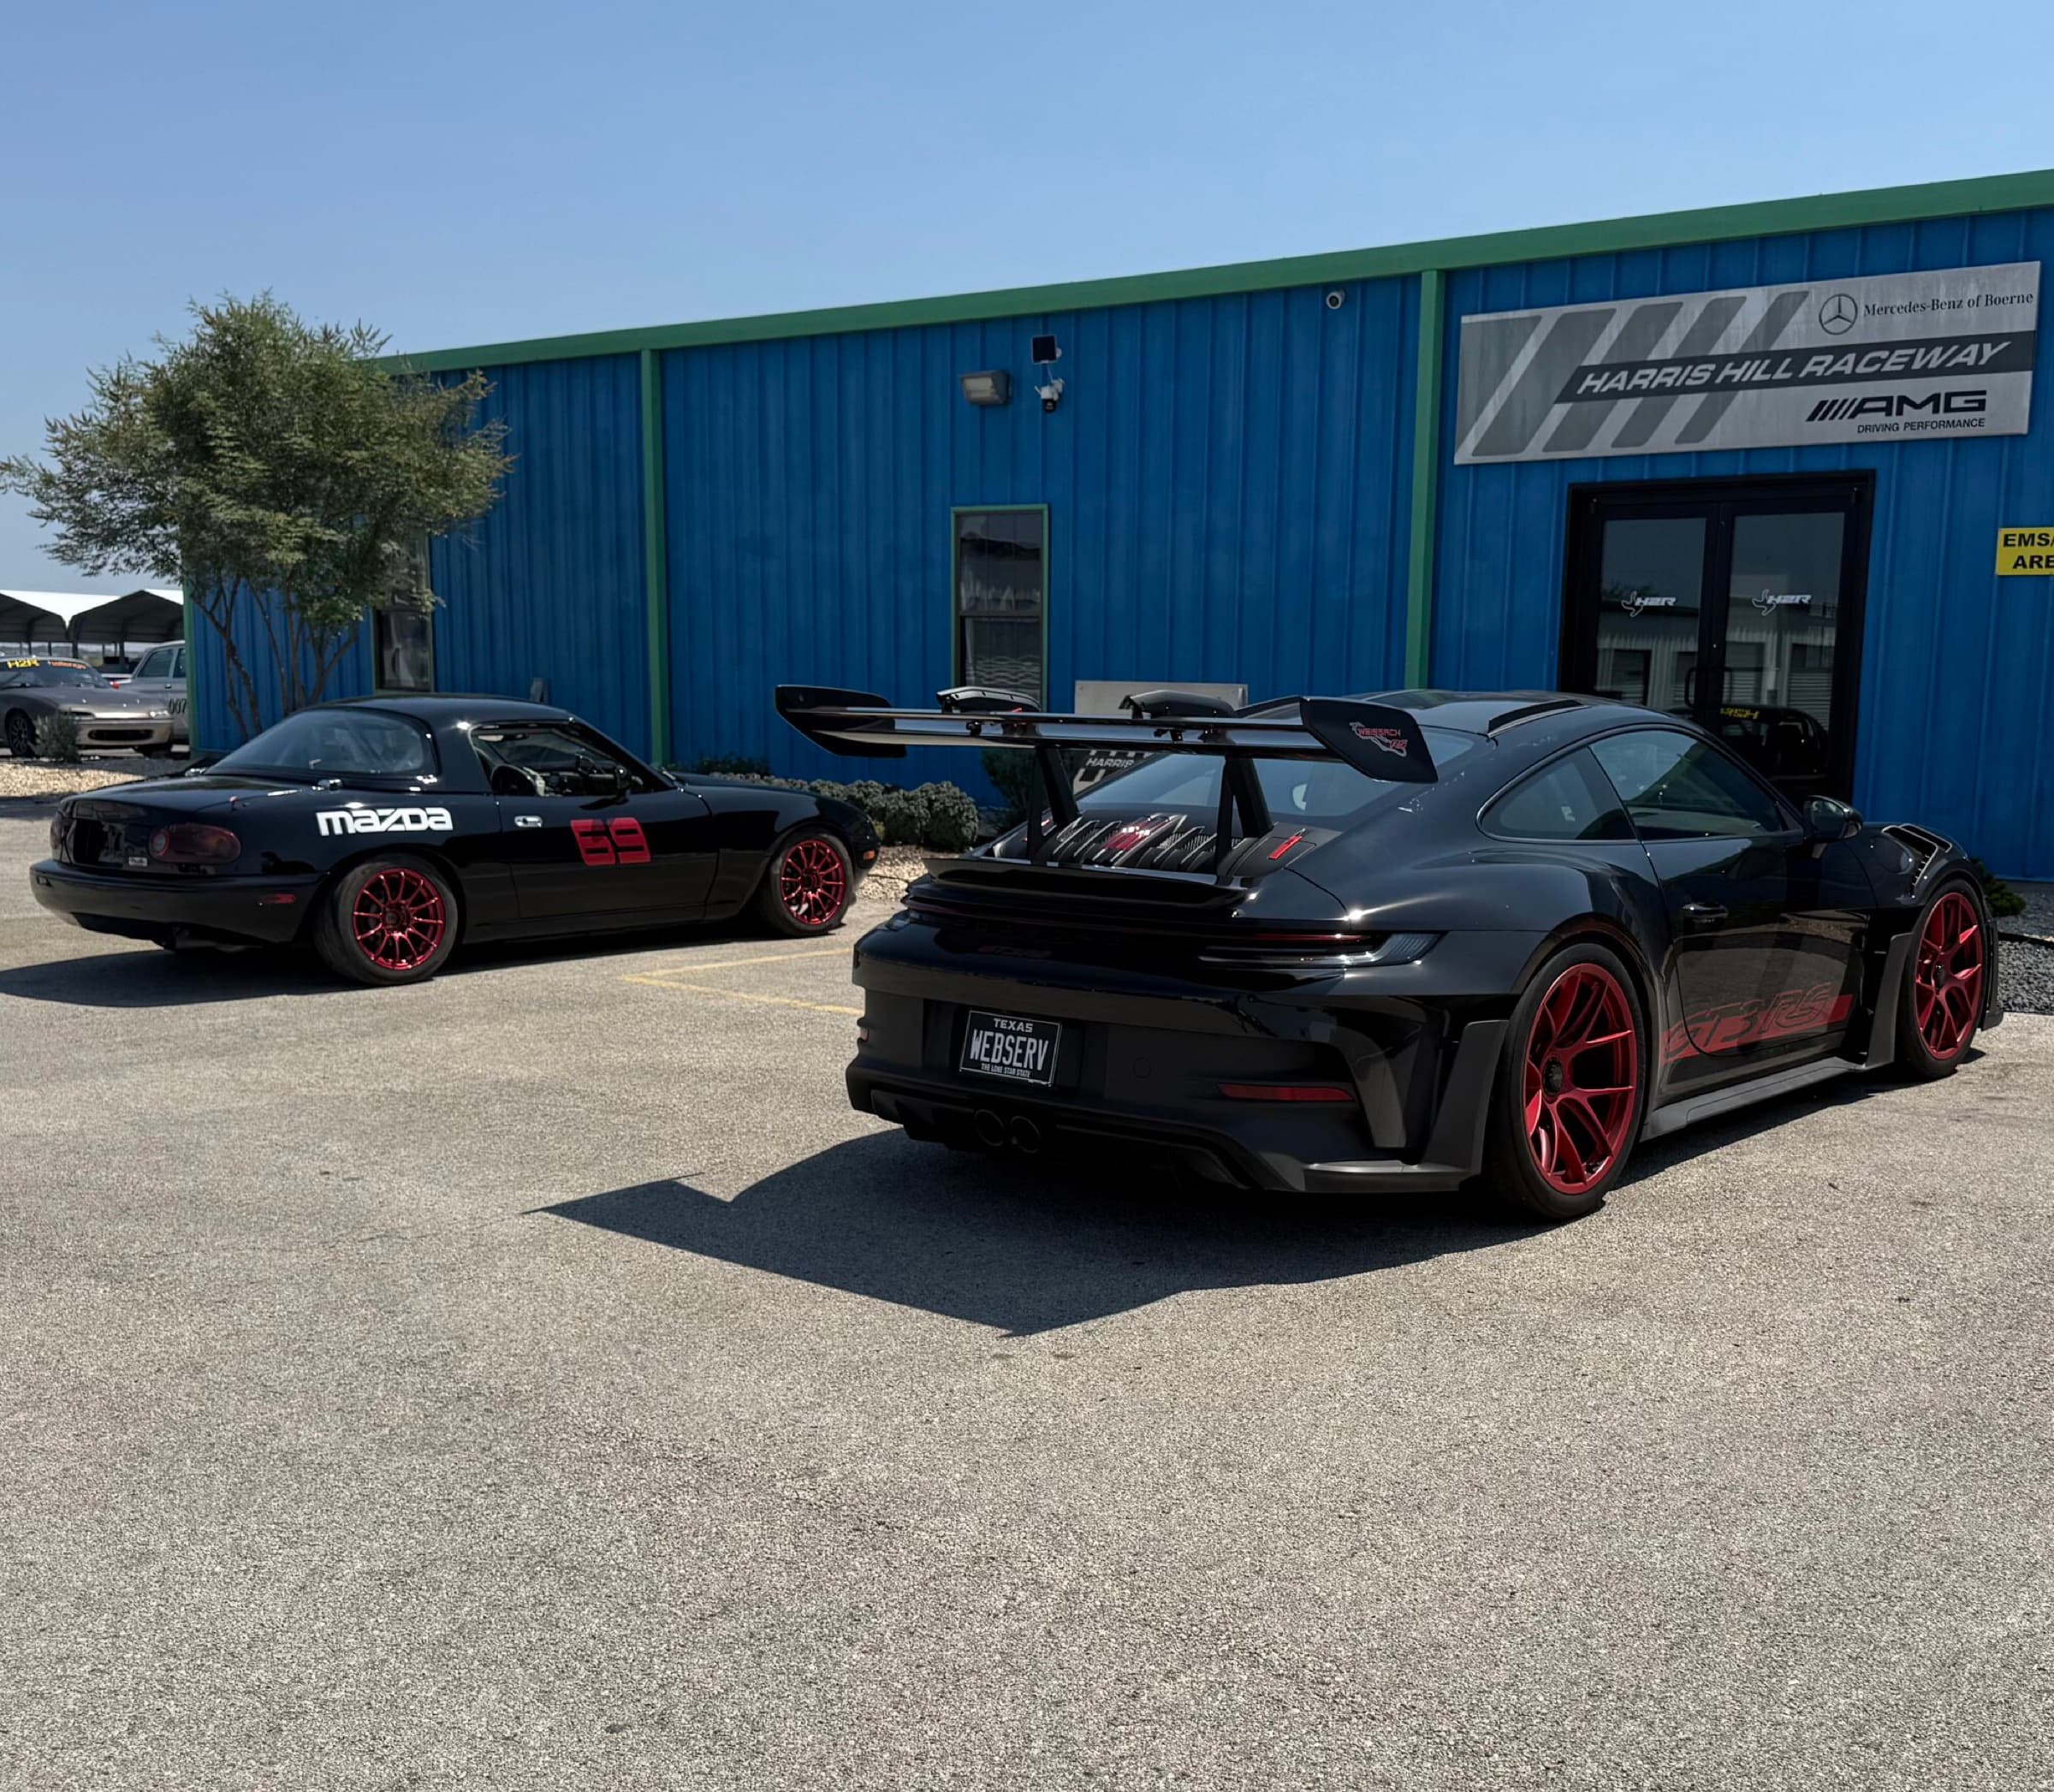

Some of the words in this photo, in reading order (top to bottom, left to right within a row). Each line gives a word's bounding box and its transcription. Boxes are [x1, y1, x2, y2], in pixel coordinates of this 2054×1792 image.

[1863, 299, 1963, 317] Mercedes-Benz
[1968, 294, 1982, 308] of
[1985, 293, 2033, 307] Boerne
[1576, 364, 1716, 395] HARRIS
[1714, 358, 1792, 383] HILL
[1799, 341, 2012, 377] RACEWAY
[1857, 422, 1899, 434] DRIVING
[1903, 418, 1986, 431] PERFORMANCE
[1085, 757, 1135, 768] HARRIS
[570, 816, 651, 866] 69
[994, 1018, 1034, 1033] TEXAS
[970, 1029, 1049, 1071] WEBSERV
